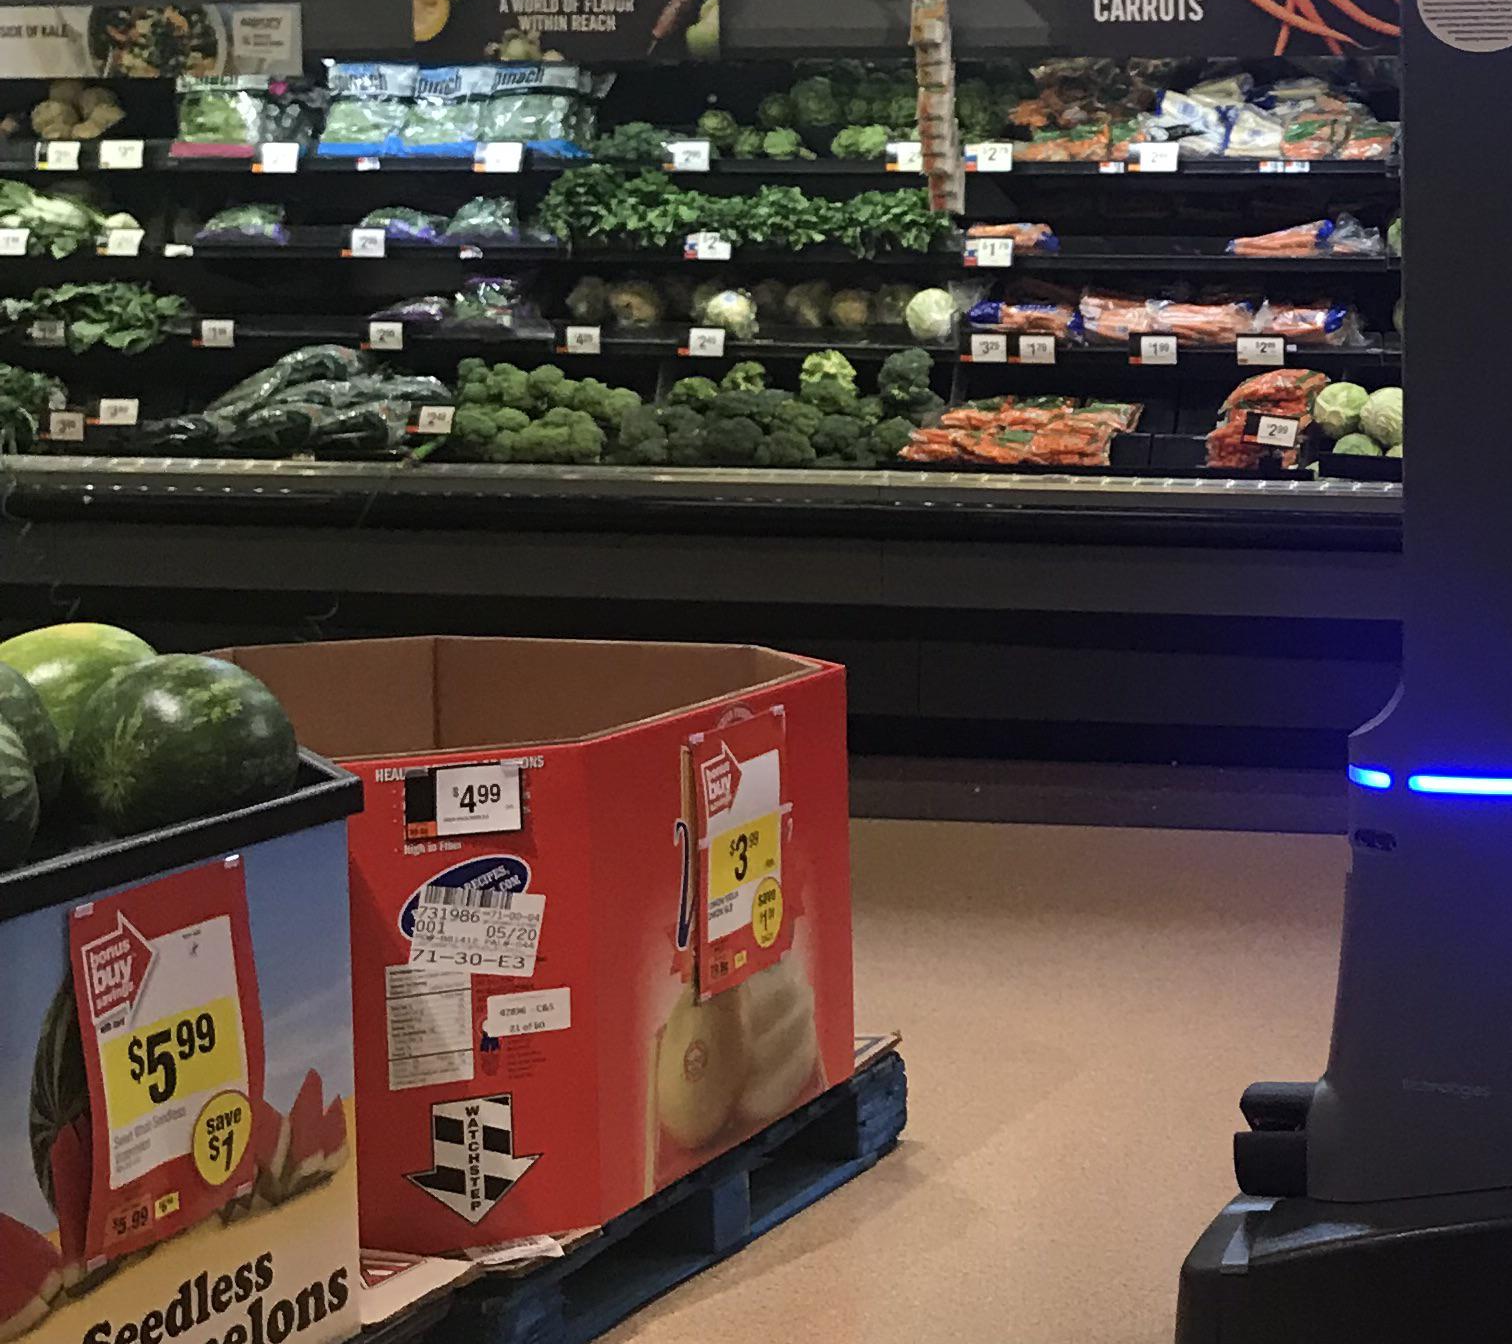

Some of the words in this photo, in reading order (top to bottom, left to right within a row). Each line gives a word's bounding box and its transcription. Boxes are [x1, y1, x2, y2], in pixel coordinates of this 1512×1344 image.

[518, 15, 569, 31] WITHIN
[572, 15, 616, 31] REACH
[418, 905, 480, 923] 731986
[416, 919, 446, 935] 001
[486, 925, 537, 942] 05/20
[413, 948, 525, 969] 71-30-E3
[206, 1107, 242, 1136] save
[465, 1105, 480, 1164] WATCH
[208, 1129, 234, 1173] $1
[469, 1165, 482, 1212] STEP
